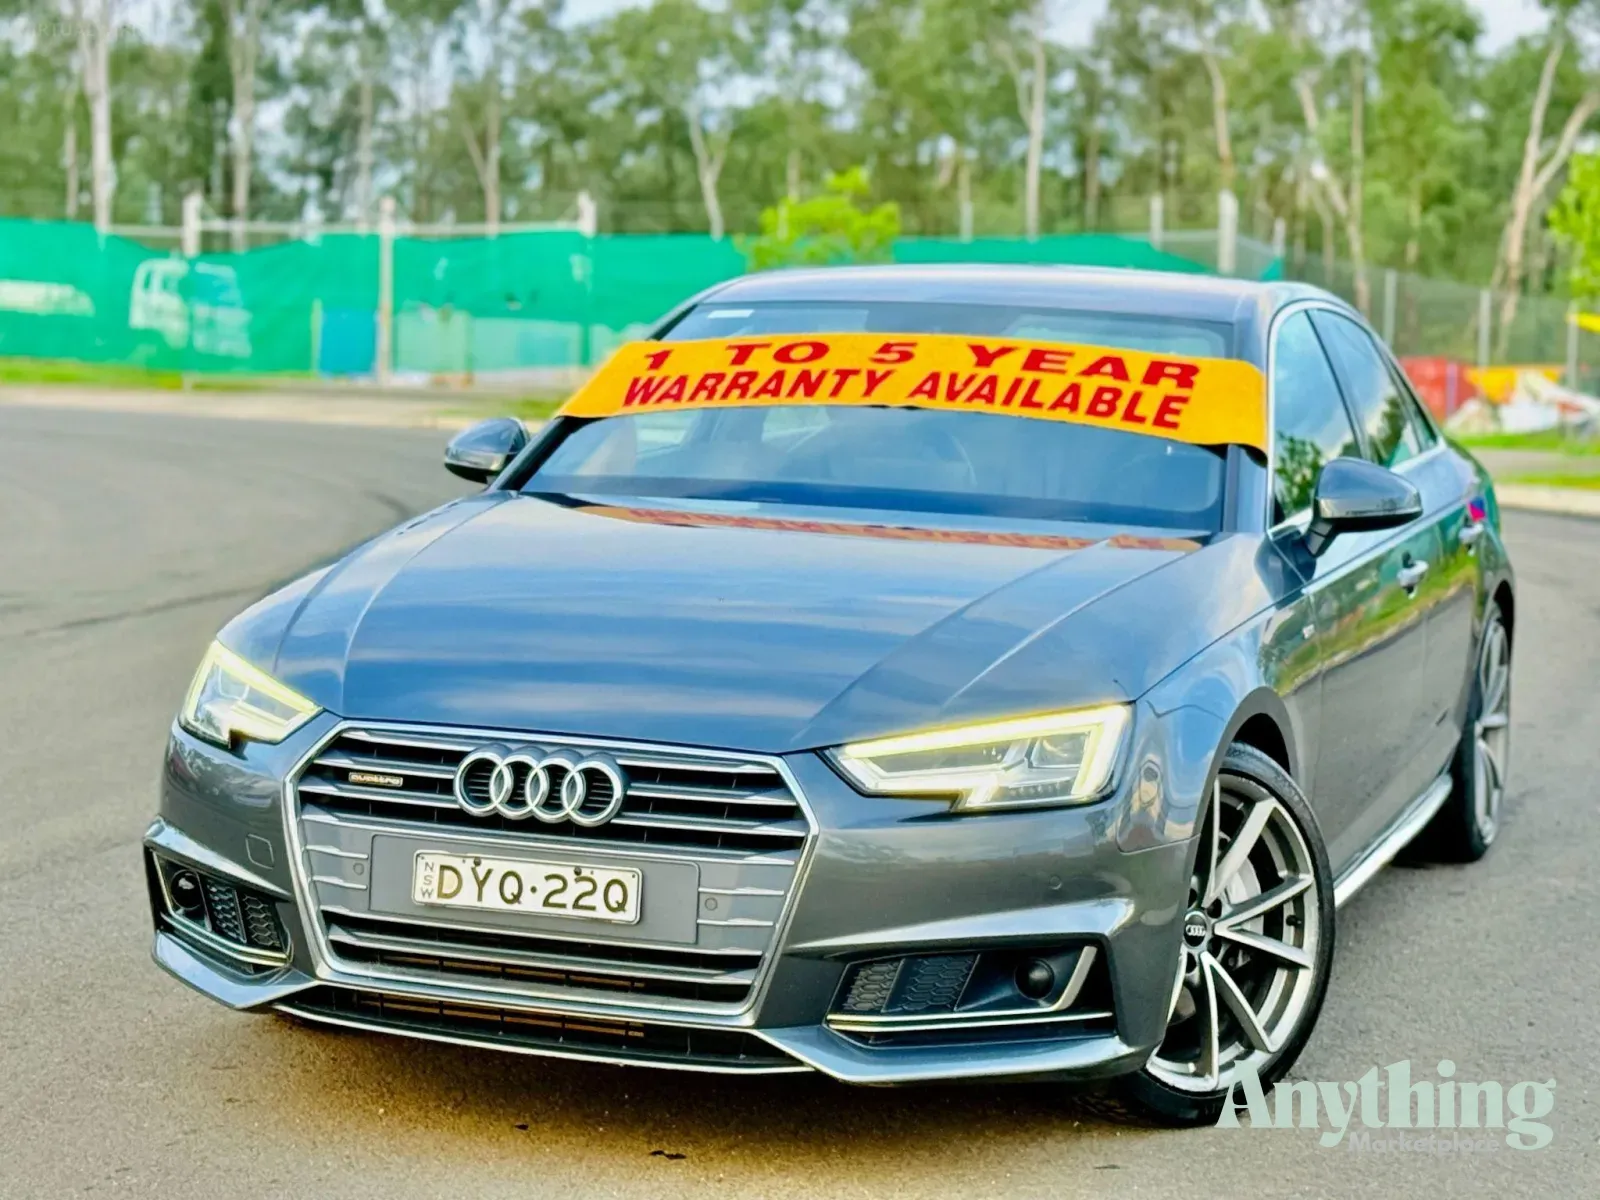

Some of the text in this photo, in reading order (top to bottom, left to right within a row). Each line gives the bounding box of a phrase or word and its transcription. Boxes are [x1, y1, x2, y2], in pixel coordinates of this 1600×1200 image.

[644, 341, 1200, 390] 1 TO 5 YEAR
[622, 368, 1193, 430] WARRANTY AVAILABLE
[421, 862, 434, 899] NSW
